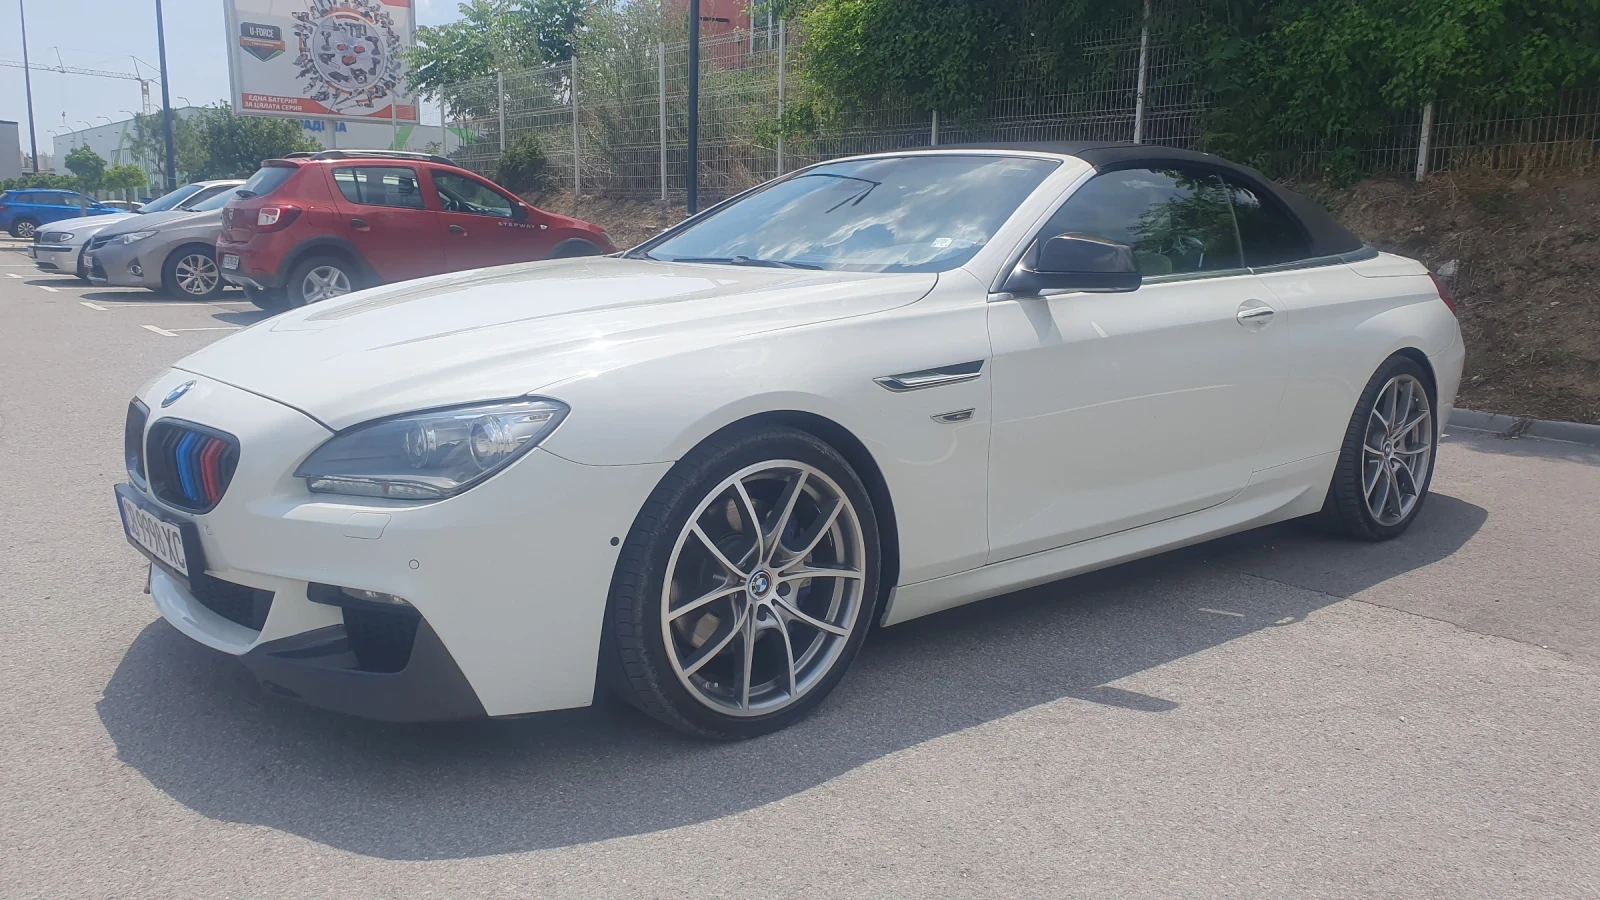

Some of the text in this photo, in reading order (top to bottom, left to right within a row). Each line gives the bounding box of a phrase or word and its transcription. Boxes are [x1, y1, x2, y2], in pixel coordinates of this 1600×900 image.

[249, 26, 274, 38] U-FORCE
[248, 94, 298, 104] ЕДНА БАТЕРИЯ
[254, 102, 281, 110] ЦЯЛАТА
[497, 221, 536, 229] STEPWAY
